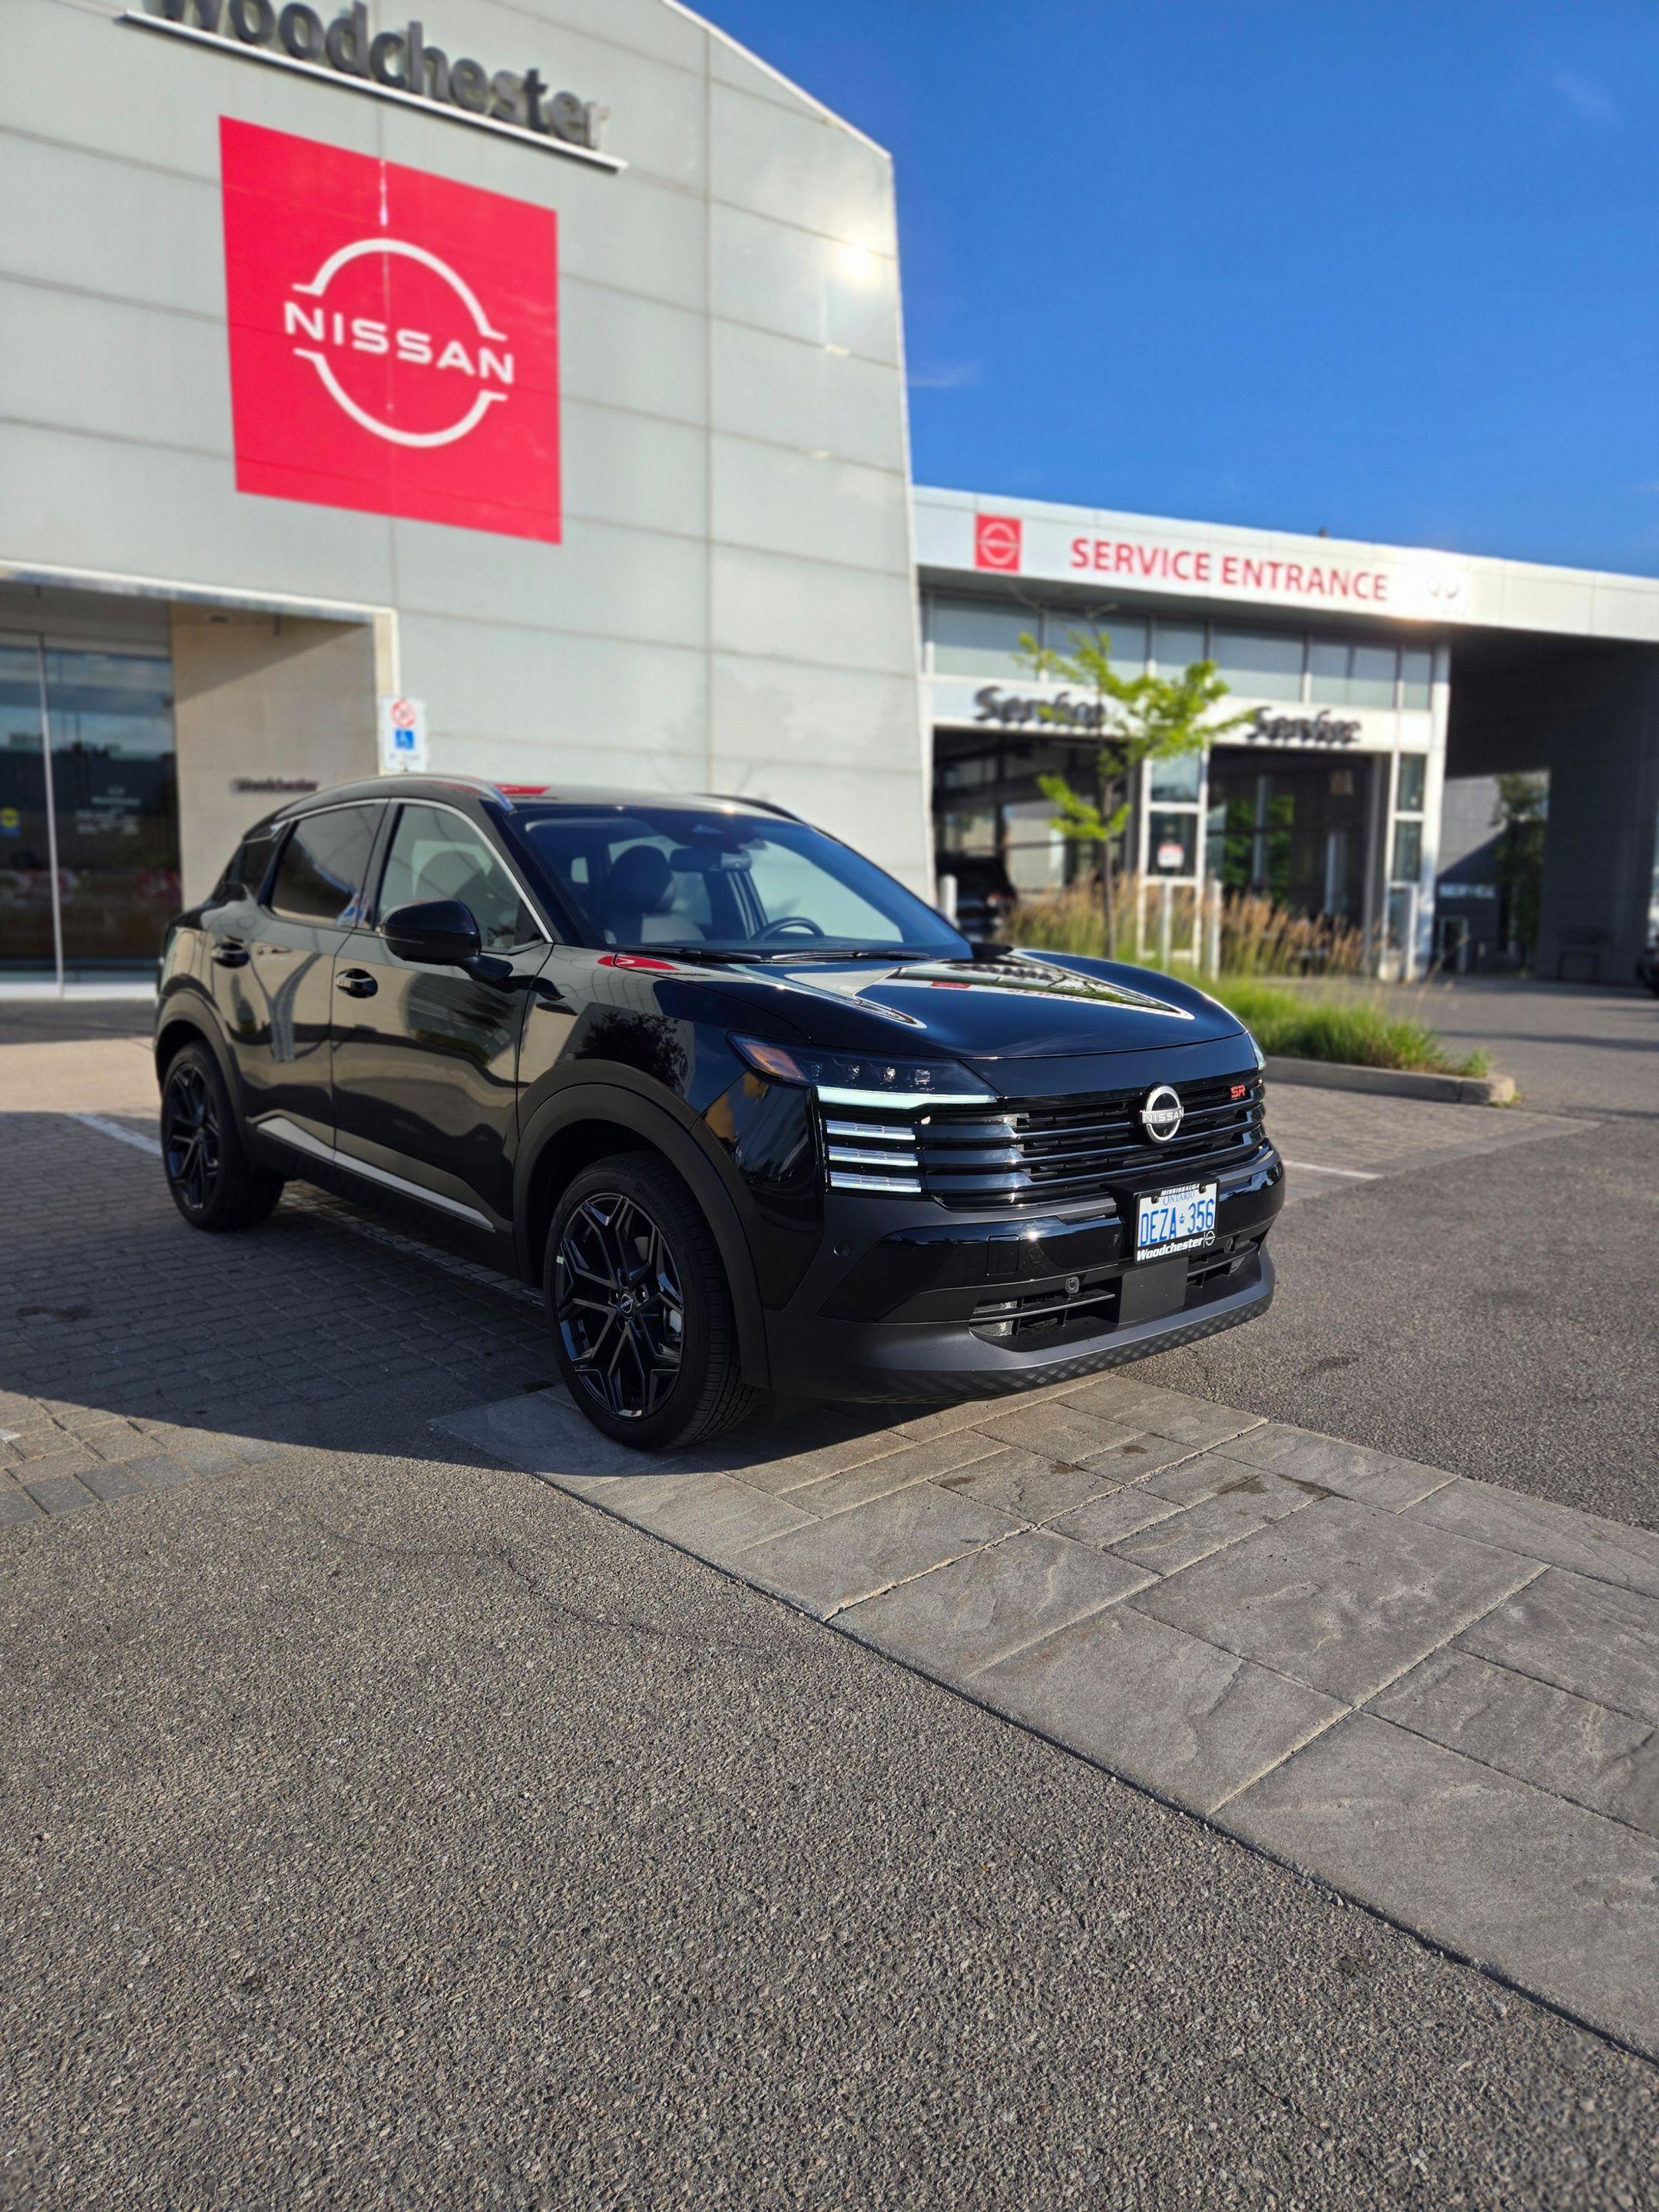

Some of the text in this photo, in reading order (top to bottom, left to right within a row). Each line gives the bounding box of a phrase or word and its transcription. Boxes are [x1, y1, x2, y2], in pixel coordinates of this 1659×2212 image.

[284, 302, 514, 385] NISSAN
[1071, 536, 1389, 601] SERVICE ENTRANCE
[1230, 1084, 1246, 1098] SR
[1143, 1106, 1184, 1122] NISSAN
[1161, 1184, 1200, 1196] MISSISSAUGA
[1163, 1190, 1195, 1206] ONTARIO
[1141, 1198, 1214, 1247] DEZA 356
[1137, 1237, 1204, 1262] Woodchester
